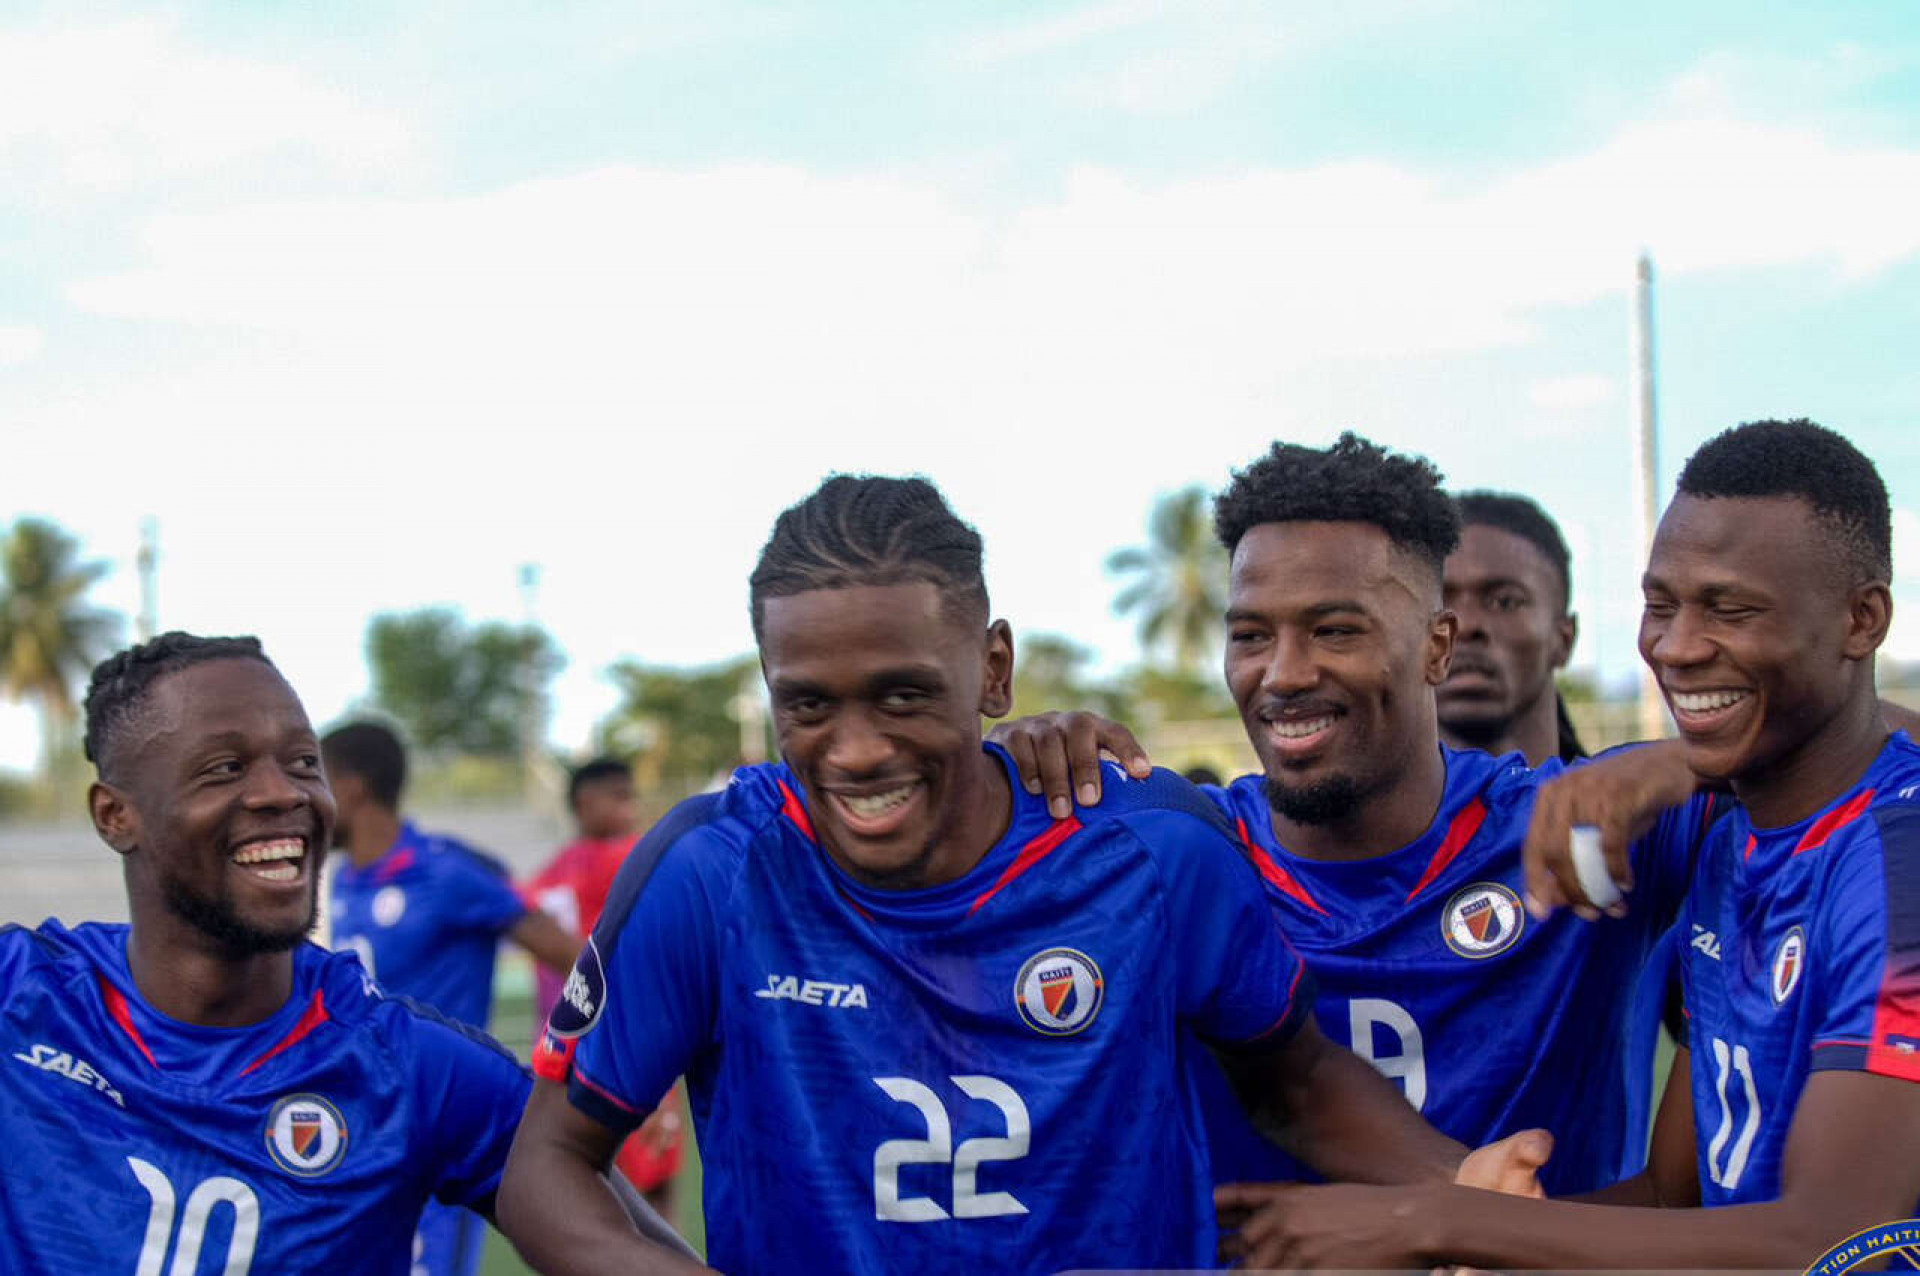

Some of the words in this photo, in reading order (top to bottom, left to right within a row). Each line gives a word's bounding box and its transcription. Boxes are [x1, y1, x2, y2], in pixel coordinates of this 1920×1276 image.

[754, 974, 868, 1008] SAETA
[13, 1044, 125, 1108] SAETA
[1349, 998, 1427, 1113] 9
[1707, 1038, 1761, 1190] 11
[873, 1075, 1030, 1222] 22
[127, 1156, 260, 1276] 10
